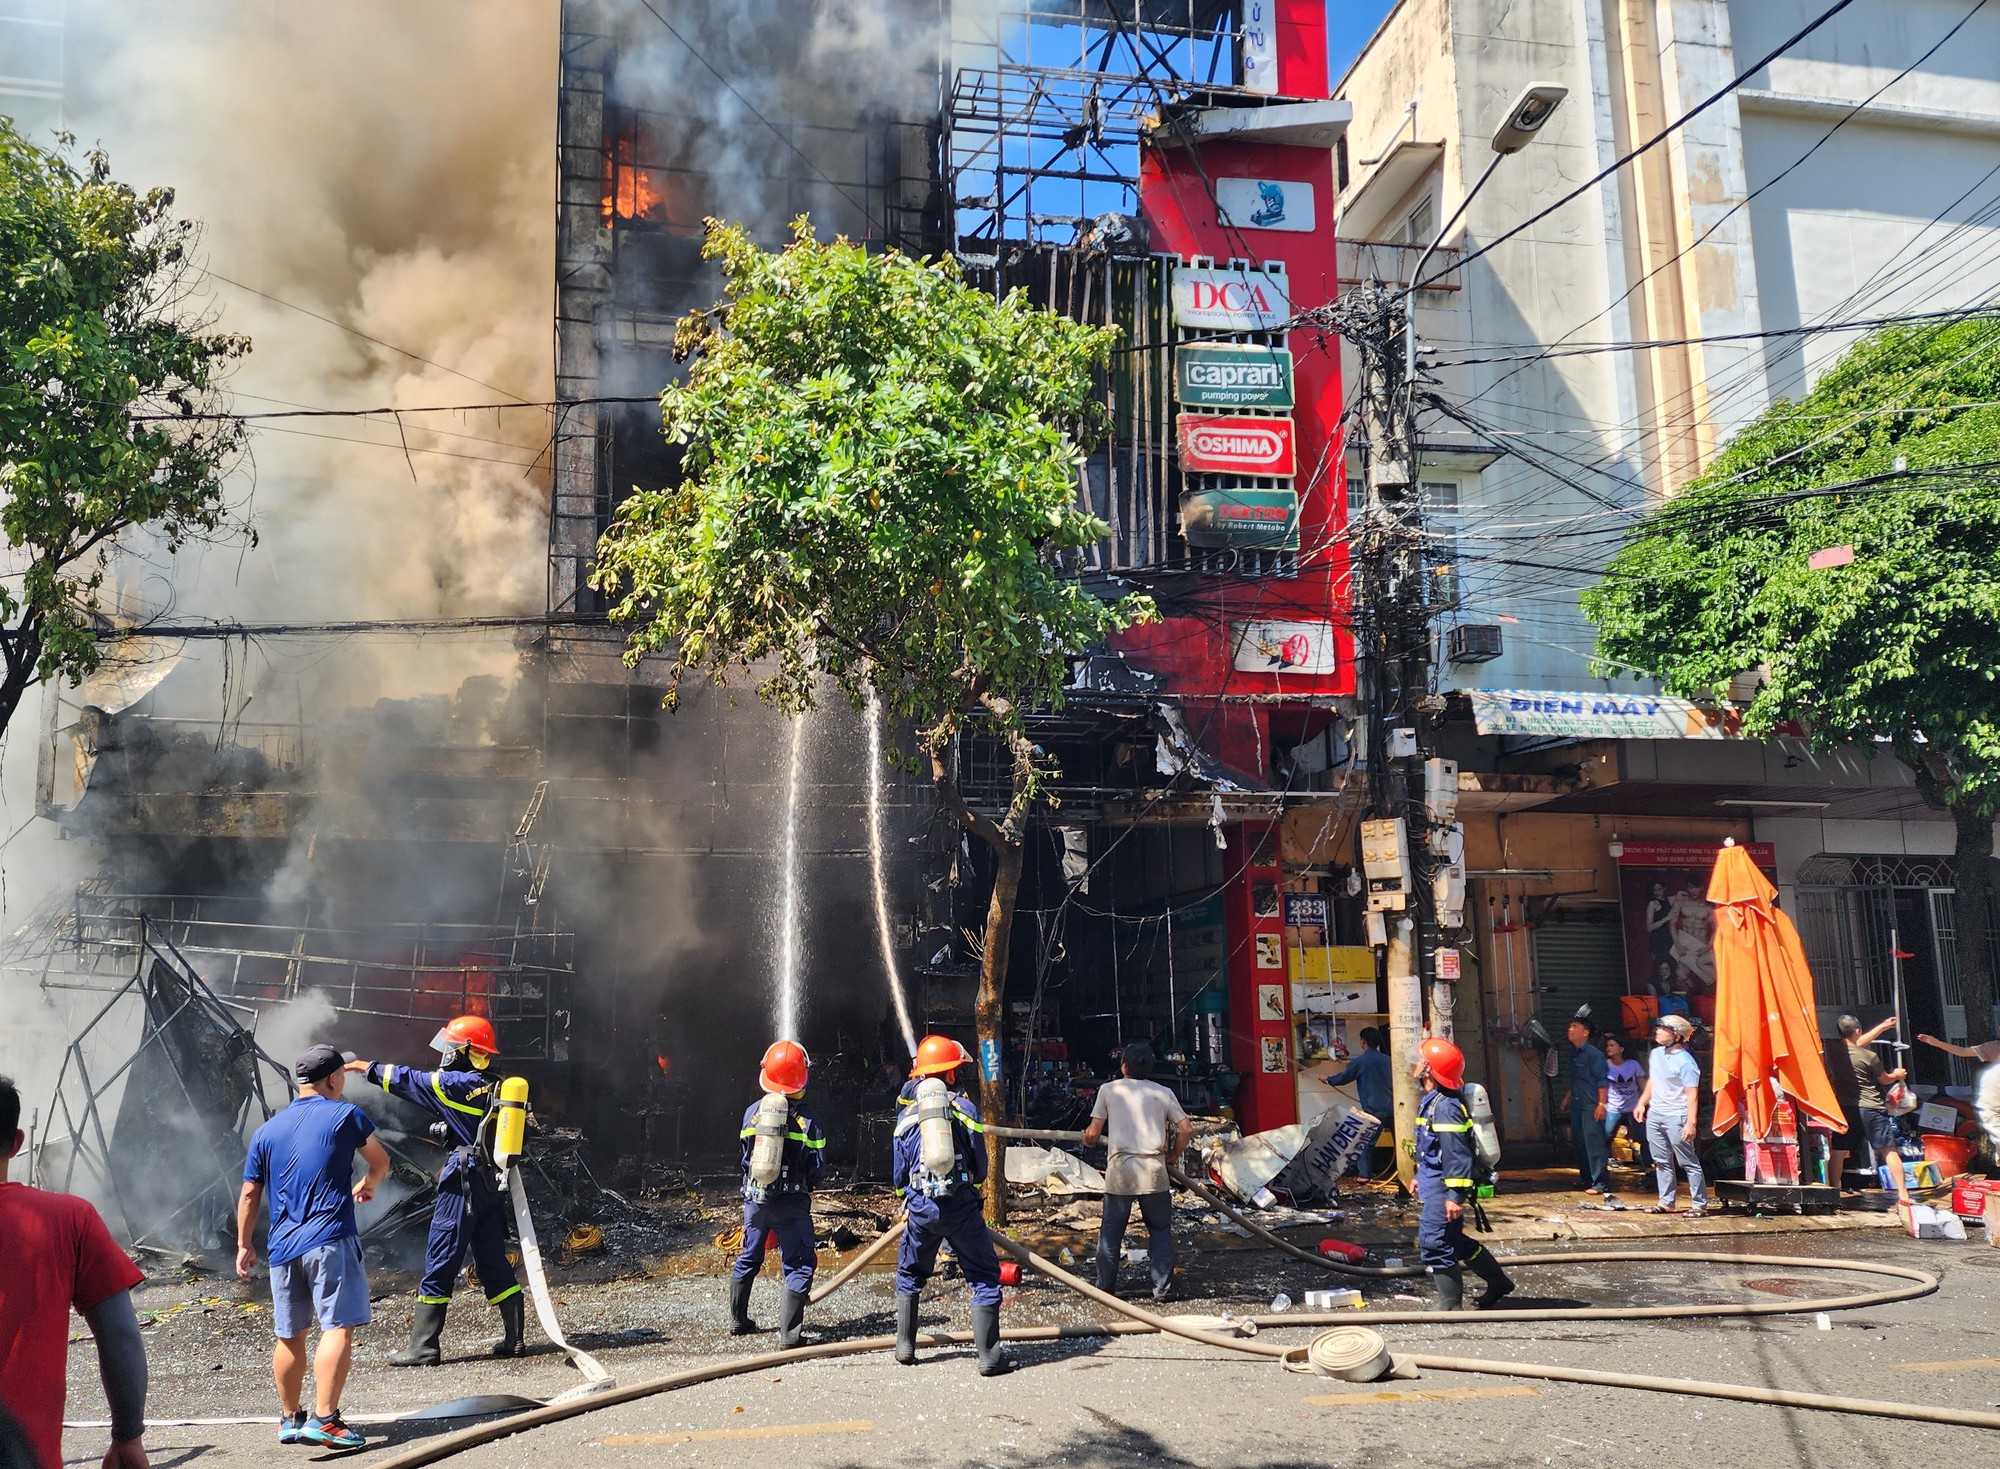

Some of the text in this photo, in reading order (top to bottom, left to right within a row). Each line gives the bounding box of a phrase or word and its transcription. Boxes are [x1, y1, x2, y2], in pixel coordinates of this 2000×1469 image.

[1190, 280, 1272, 312] DCA
[1190, 363, 1278, 389] caprari
[1202, 391, 1269, 402] pumping power
[1199, 435, 1273, 455] OSHIMA
[1218, 504, 1290, 521] DEKTON
[1217, 522, 1226, 530] by
[1228, 522, 1254, 530] Robert
[1510, 697, 1584, 718] ĐIỆN
[1592, 699, 1662, 716] MÁY
[1290, 900, 1323, 916] 233
[1312, 1141, 1341, 1174] HÀN
